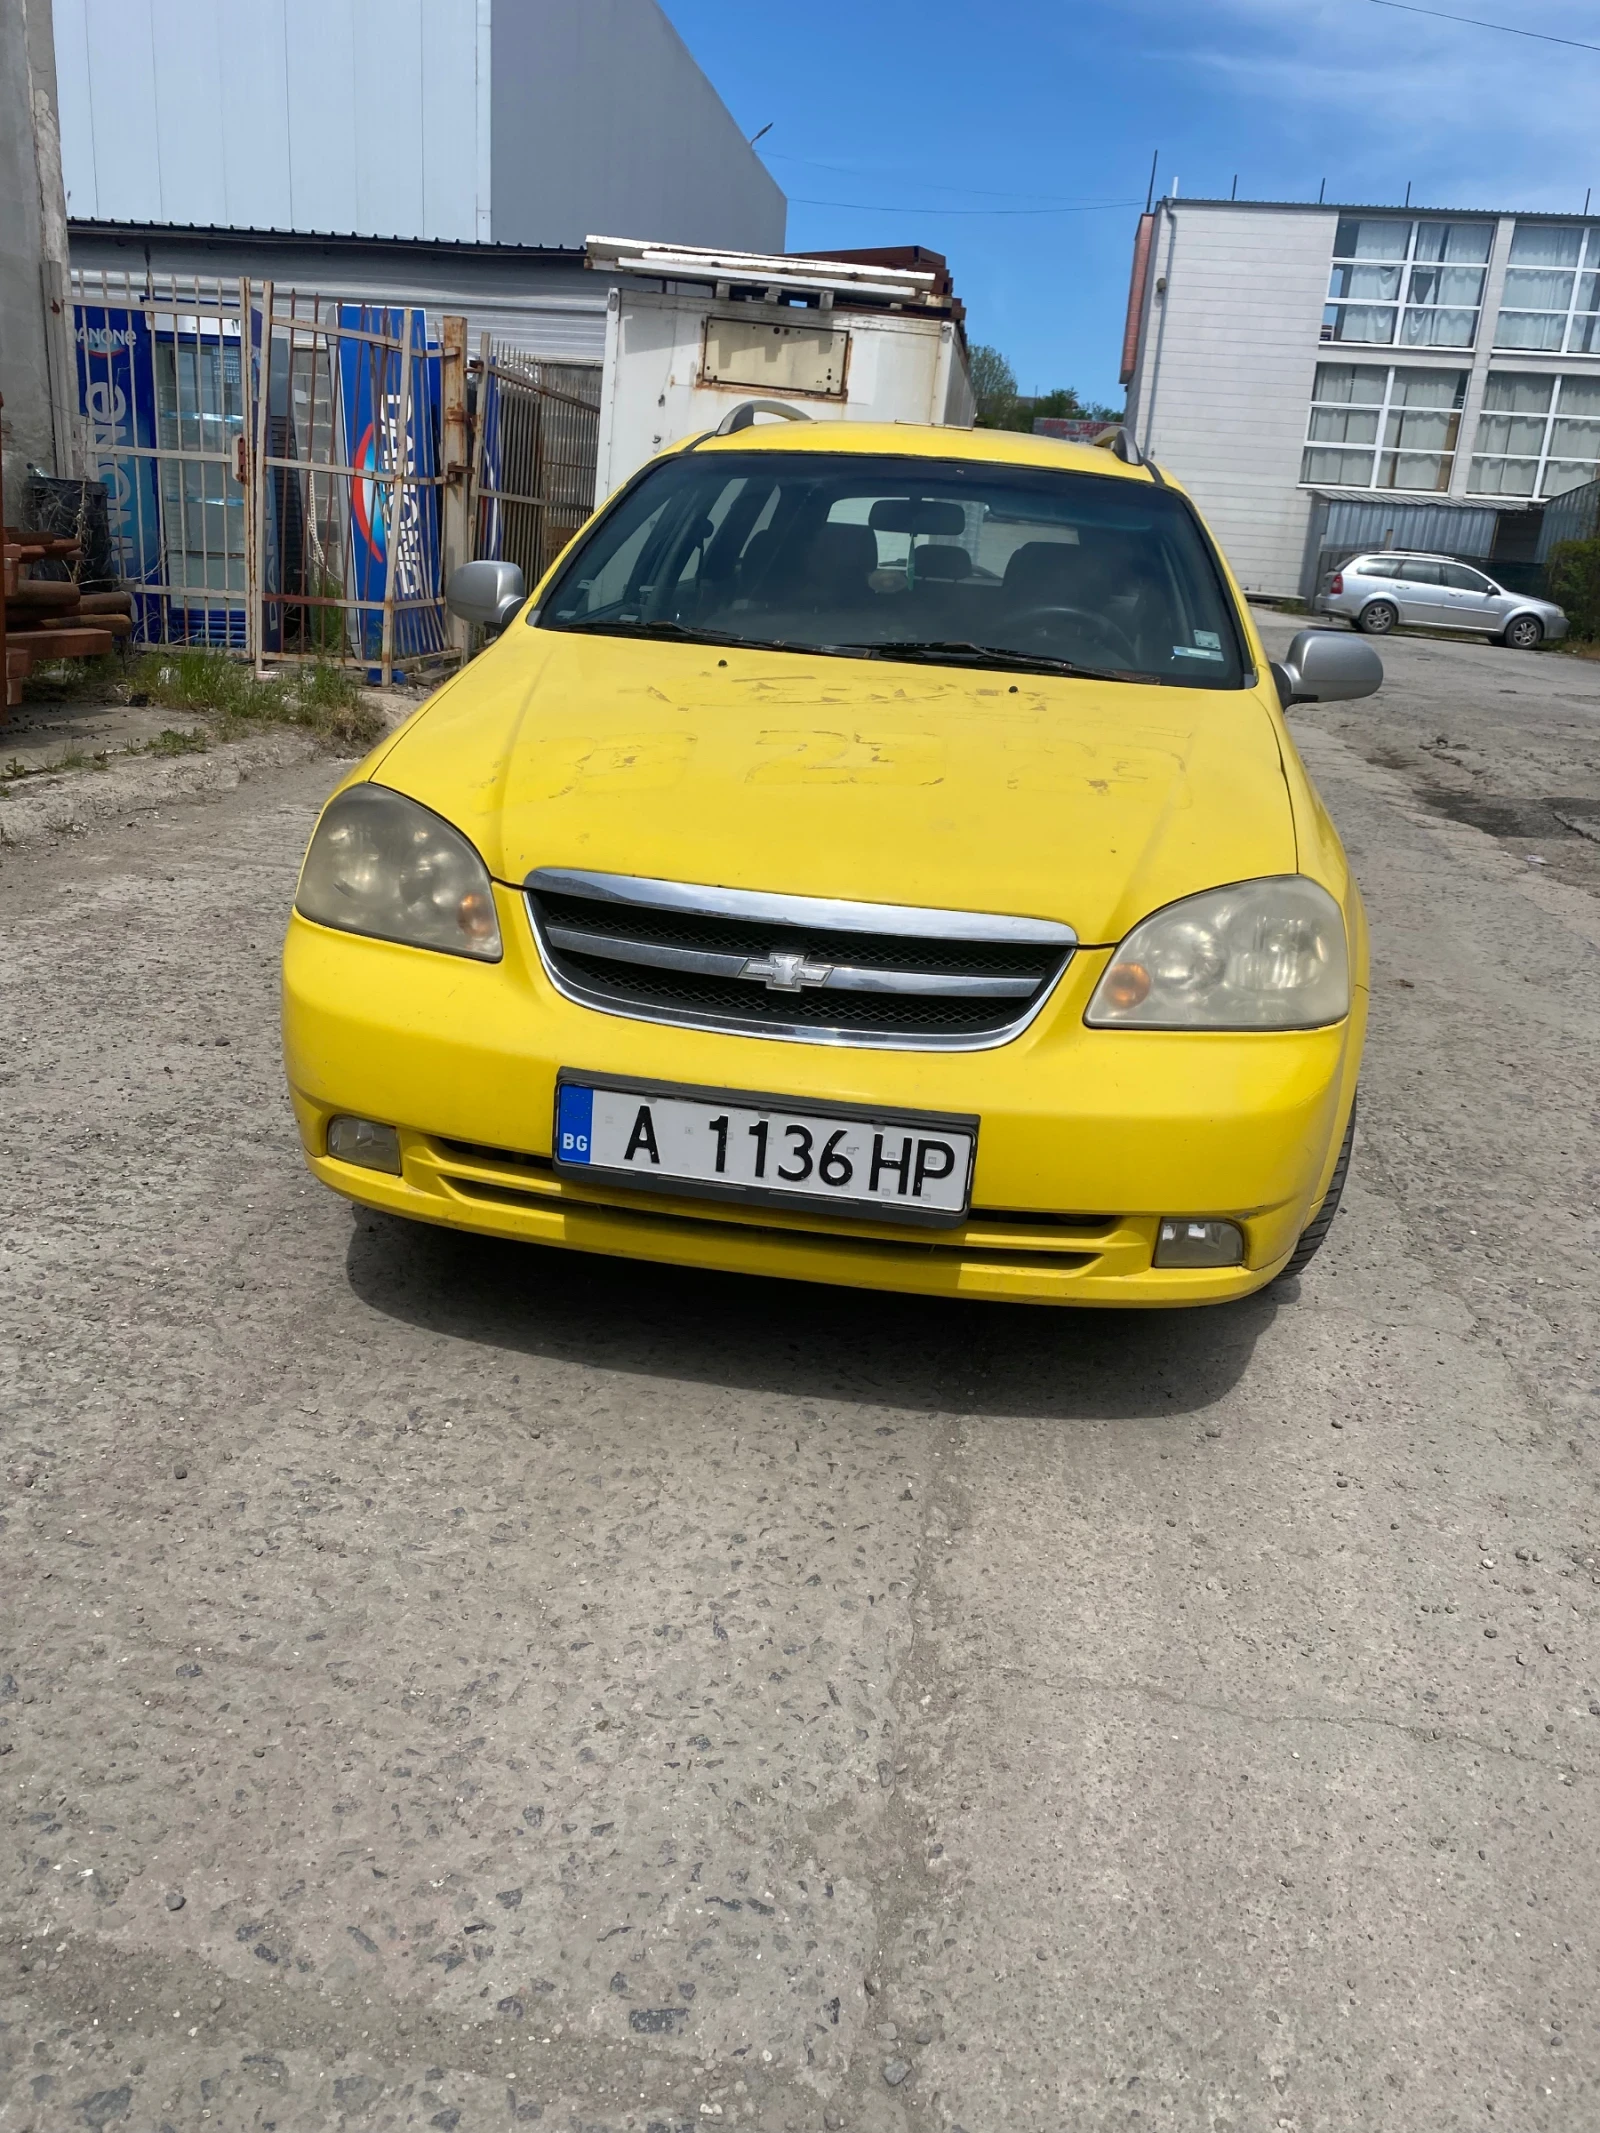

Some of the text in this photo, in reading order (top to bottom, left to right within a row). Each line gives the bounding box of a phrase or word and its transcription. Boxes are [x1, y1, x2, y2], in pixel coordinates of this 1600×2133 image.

[74, 327, 137, 346] ANONe
[562, 1132, 588, 1152] BG
[623, 1105, 956, 1197] A 1136 HP
